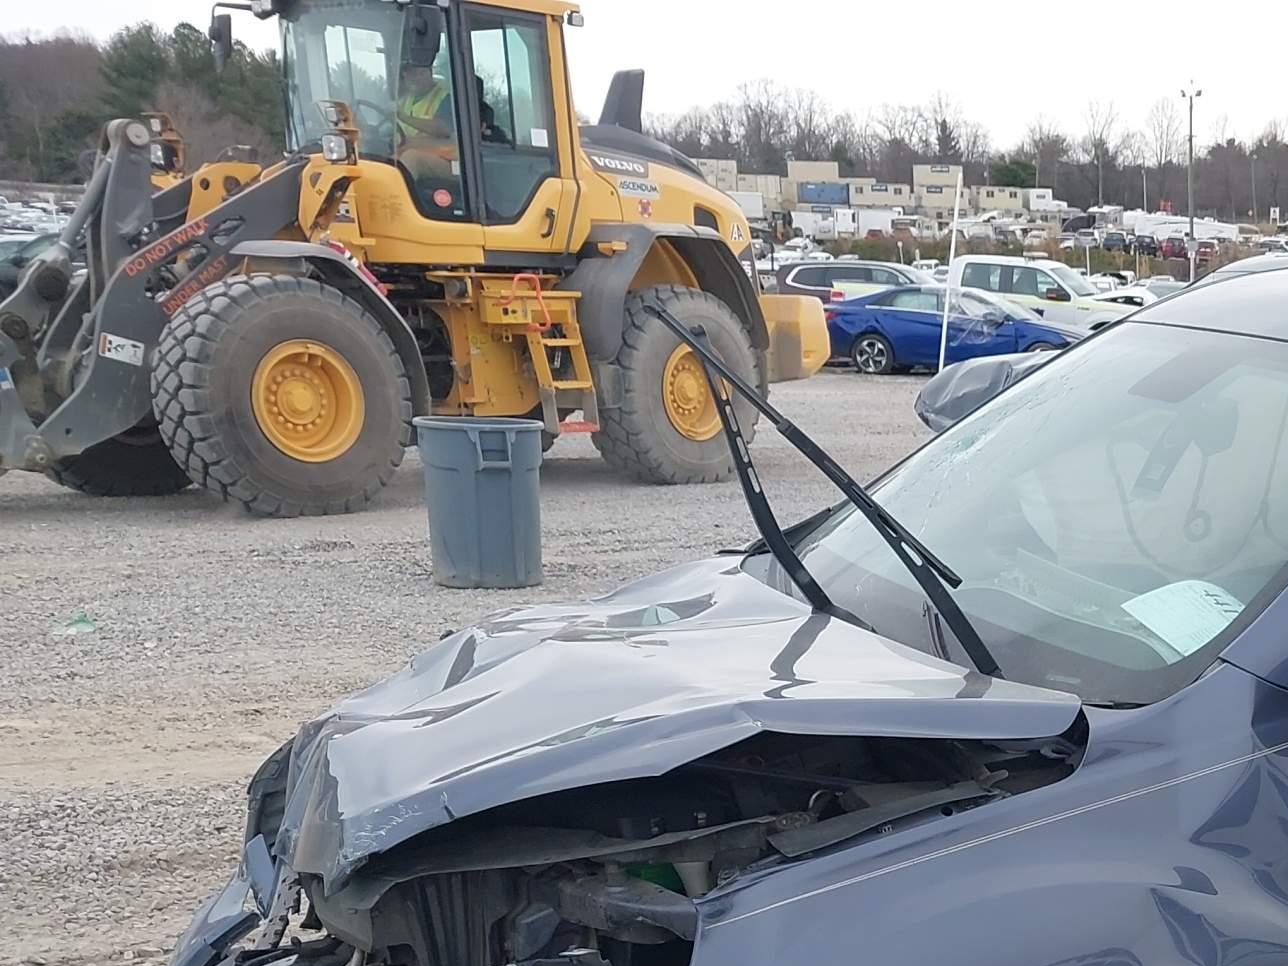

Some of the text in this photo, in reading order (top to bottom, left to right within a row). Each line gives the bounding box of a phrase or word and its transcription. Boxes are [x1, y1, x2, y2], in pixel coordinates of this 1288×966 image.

[591, 156, 644, 173] VOLVO
[618, 181, 659, 193] ASCENDUM
[125, 219, 209, 276] DO NOT WALK
[162, 255, 227, 315] UNDER MAST
